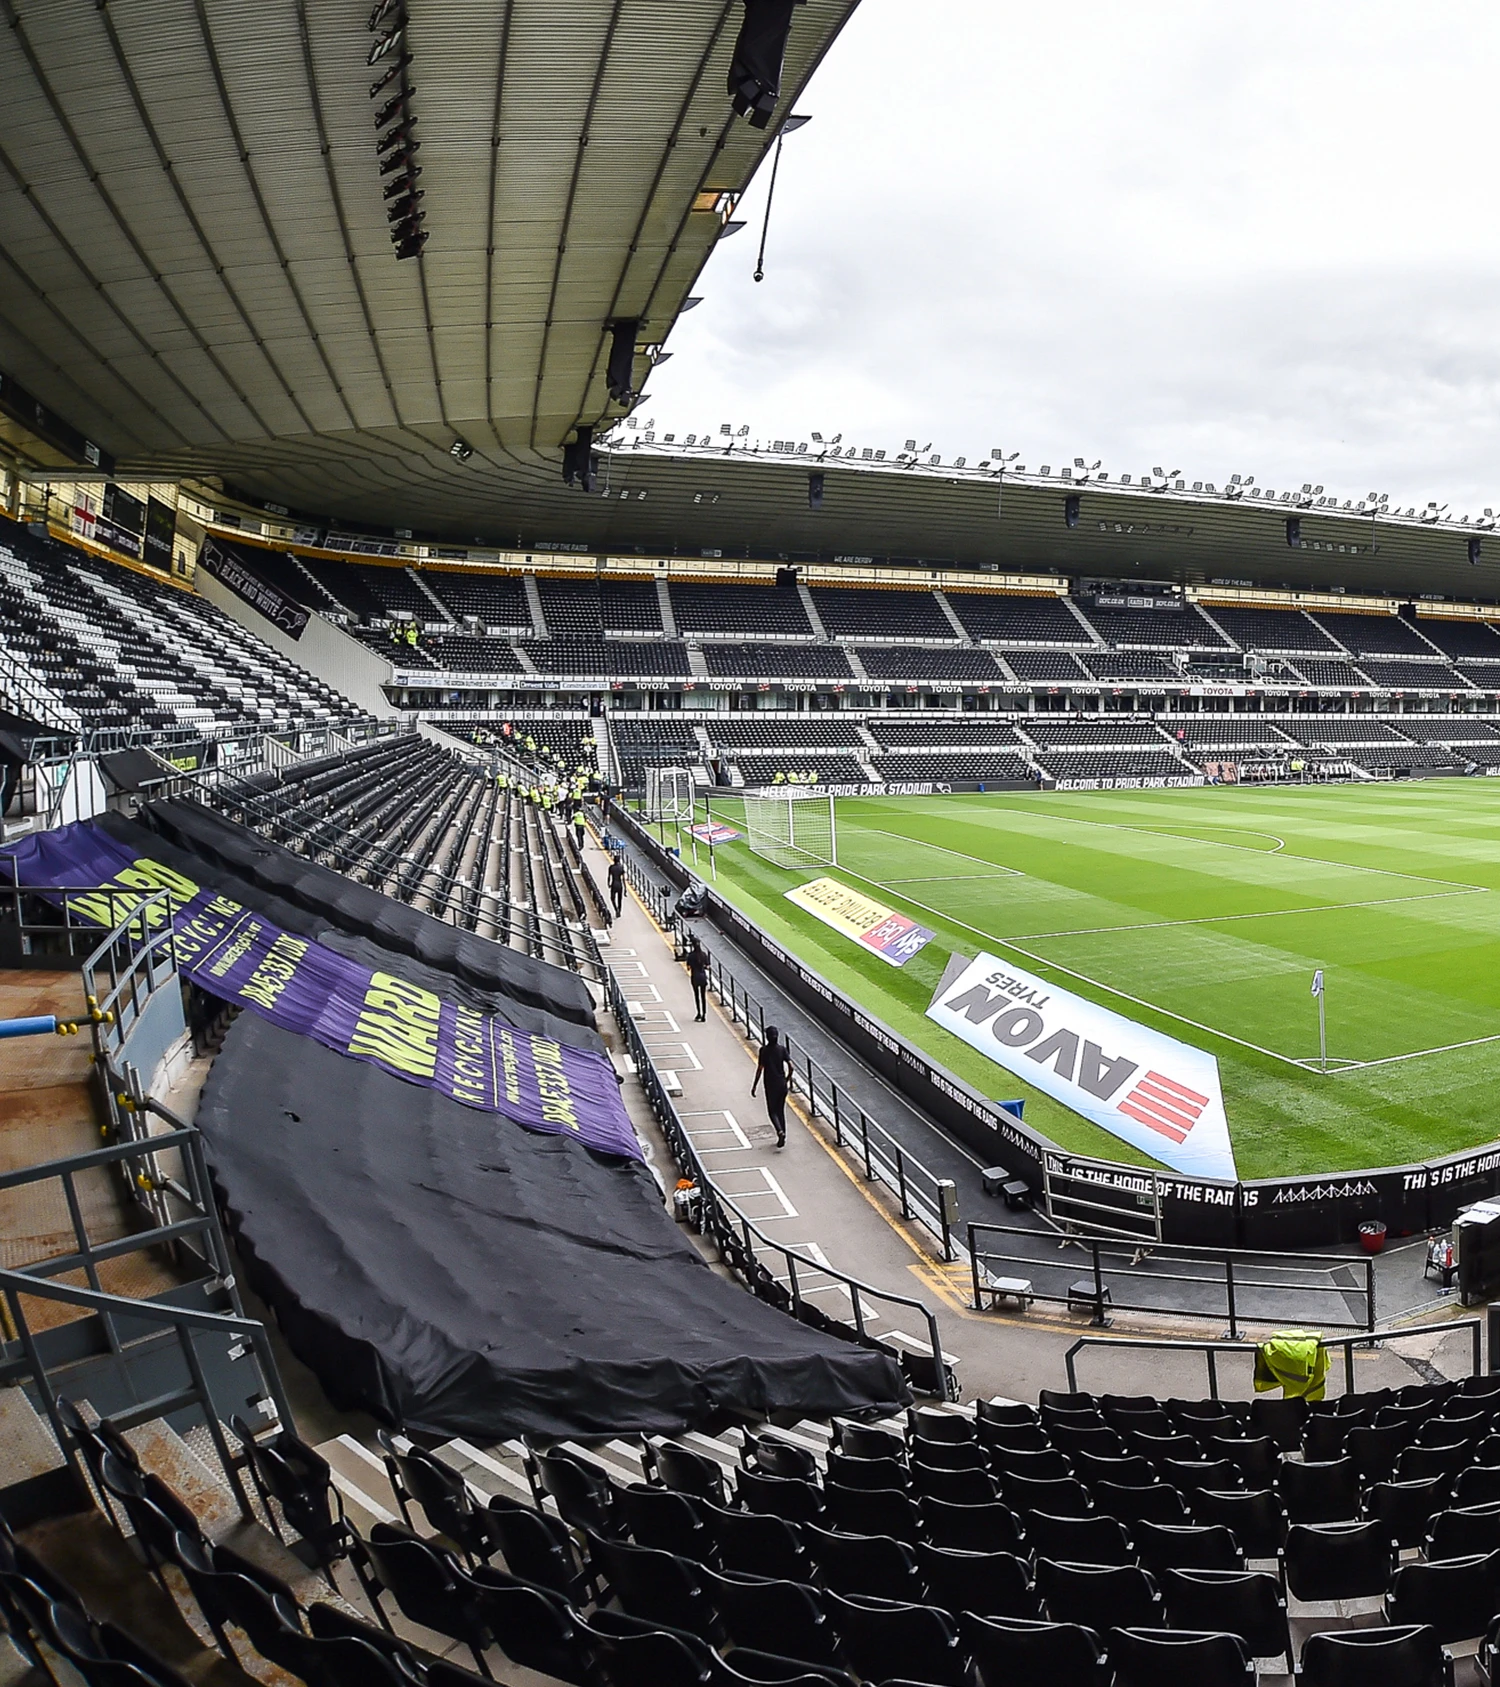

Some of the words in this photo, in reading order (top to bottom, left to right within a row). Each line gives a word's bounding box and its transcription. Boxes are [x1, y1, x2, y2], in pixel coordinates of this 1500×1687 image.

[220, 565, 244, 590] BLACK
[241, 582, 258, 600] AND
[256, 592, 280, 617] WHITE
[709, 683, 743, 691] TOYOTA
[783, 683, 817, 692] TOYOTA
[858, 685, 891, 693] TOYOTA
[1002, 686, 1033, 694] TOYOTA
[1071, 687, 1101, 695] TOYOTA
[1202, 687, 1234, 695] TOYOTA
[1264, 689, 1290, 697] TOYOTA
[828, 784, 857, 797] PRIDE
[860, 783, 887, 796] PARK
[889, 782, 933, 795] STADIUM
[1055, 776, 1100, 791] WELCOME
[1101, 777, 1113, 789] TO
[1115, 777, 1141, 789] PRIDE
[1143, 776, 1166, 788] PARK
[1167, 775, 1204, 787] STADIUM
[67, 858, 200, 940] WARD
[802, 882, 844, 906] BETTER
[831, 898, 883, 929] BETTING
[869, 919, 905, 947] bet
[892, 927, 928, 957] sky
[258, 950, 297, 982] 337
[239, 971, 286, 1009] 0845
[985, 971, 1051, 1011] TYRES
[348, 971, 441, 1077] WARD
[945, 983, 1139, 1102] AVON
[534, 1063, 572, 1096] 337
[540, 1085, 580, 1132] 0845
[930, 1071, 941, 1088] THIS
[940, 1080, 945, 1092] IS
[945, 1082, 953, 1098] THE
[953, 1088, 967, 1108] HOME
[966, 1098, 973, 1112] OF
[973, 1102, 983, 1120] THE
[982, 1109, 998, 1131] RAMS
[1048, 1156, 1064, 1173] THIS
[1071, 1168, 1085, 1178] IS
[1086, 1169, 1111, 1187] THE
[1113, 1175, 1153, 1193] HOME
[1156, 1181, 1174, 1197] OF
[1175, 1185, 1202, 1202] THE
[1403, 1171, 1439, 1190] THIS
[1441, 1168, 1453, 1184] IS
[1453, 1161, 1476, 1181] THE
